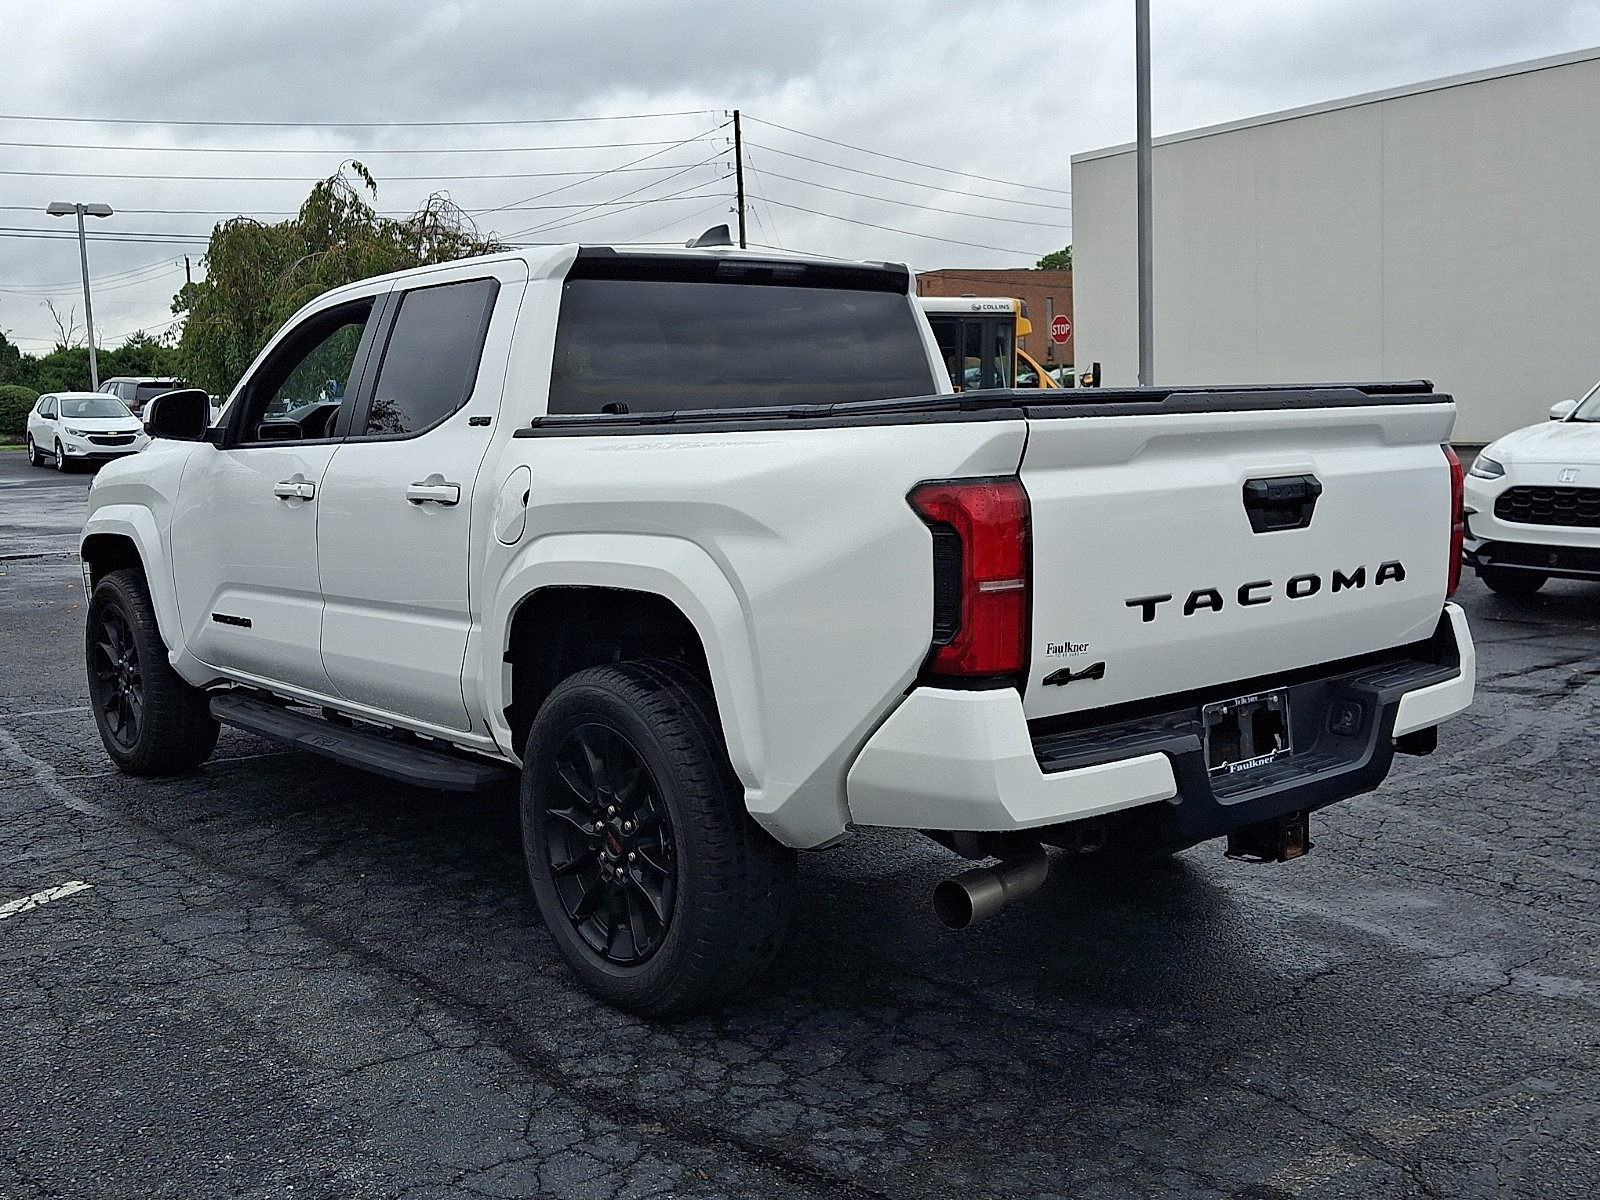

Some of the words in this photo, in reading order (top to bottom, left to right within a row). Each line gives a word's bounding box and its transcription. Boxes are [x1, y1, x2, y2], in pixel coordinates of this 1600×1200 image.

[1052, 324, 1070, 336] STOP
[1269, 484, 1305, 497] TOYOTA
[1125, 559, 1406, 623] TACOMA
[1046, 641, 1089, 654] Faulkner
[1229, 755, 1275, 774] Faulkner
